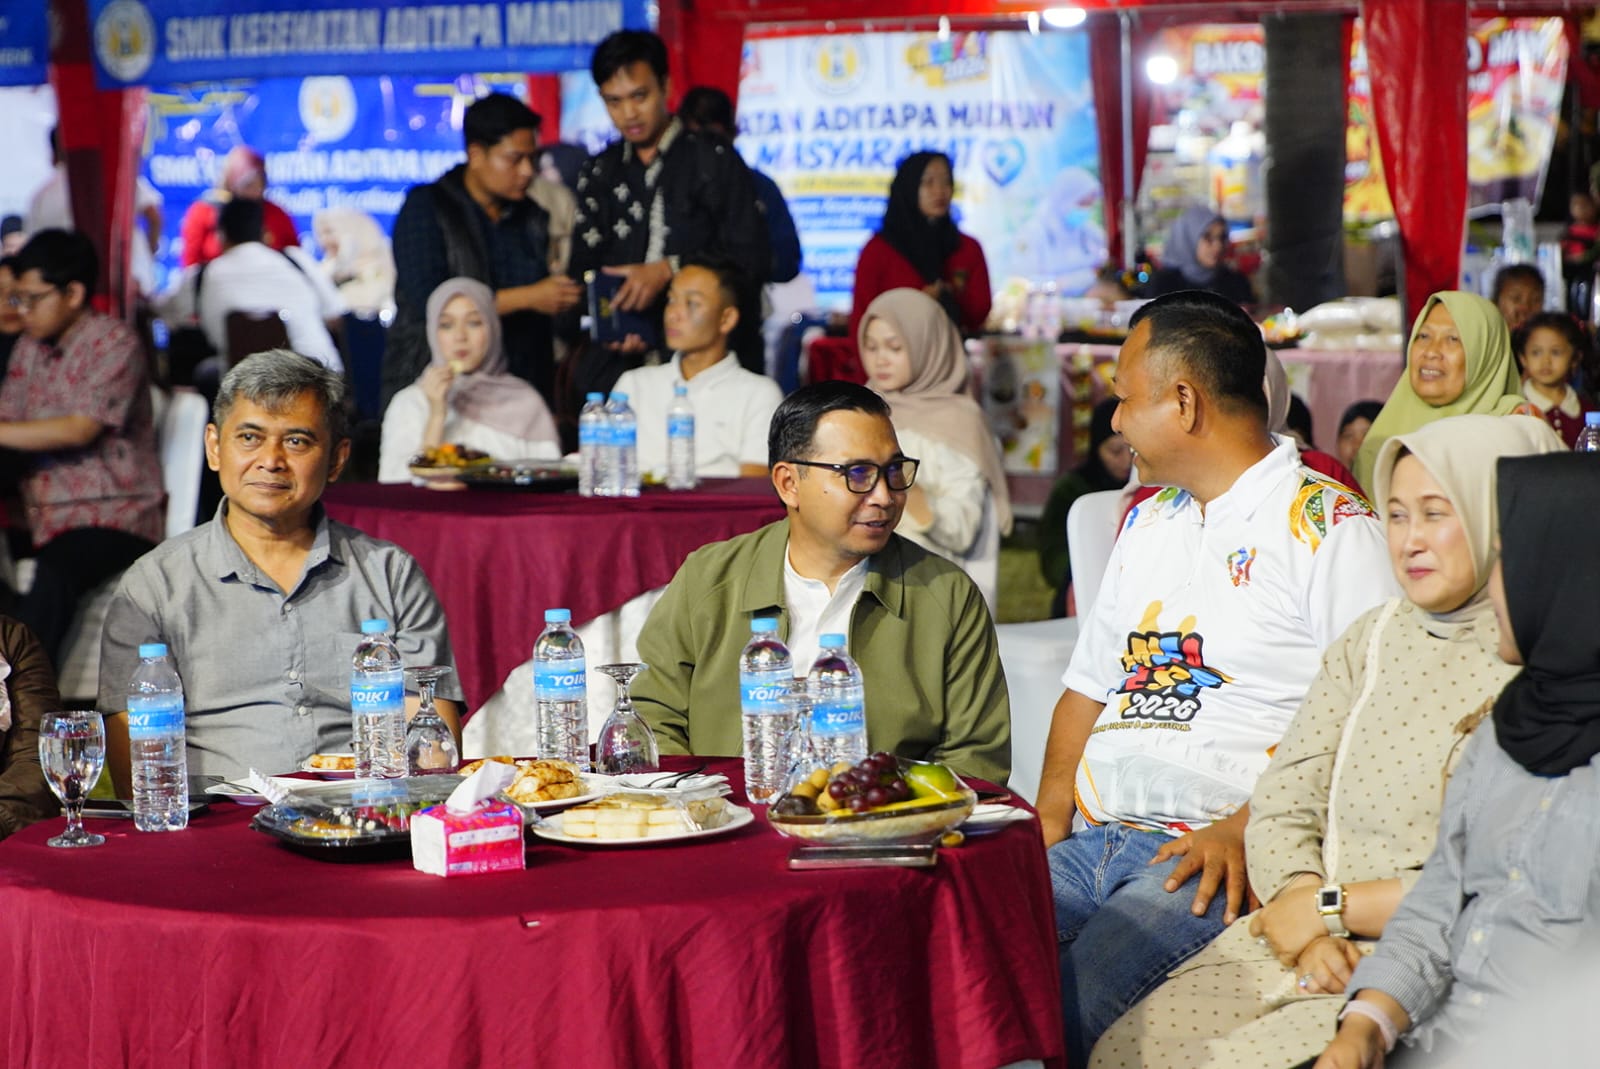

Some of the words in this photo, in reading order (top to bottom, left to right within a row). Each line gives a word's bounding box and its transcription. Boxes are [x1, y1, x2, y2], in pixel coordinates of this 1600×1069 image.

[165, 16, 227, 62] SMK
[229, 8, 380, 58] KESEHATAN
[384, 4, 499, 53] ADITAPA
[506, 0, 622, 46] MADIUN
[814, 102, 940, 131] ADITAPA
[548, 673, 585, 687] YOIK
[748, 686, 787, 701] YOIK
[1124, 693, 1198, 720] 2026
[128, 713, 150, 726] IKI
[826, 711, 864, 724] YOIK
